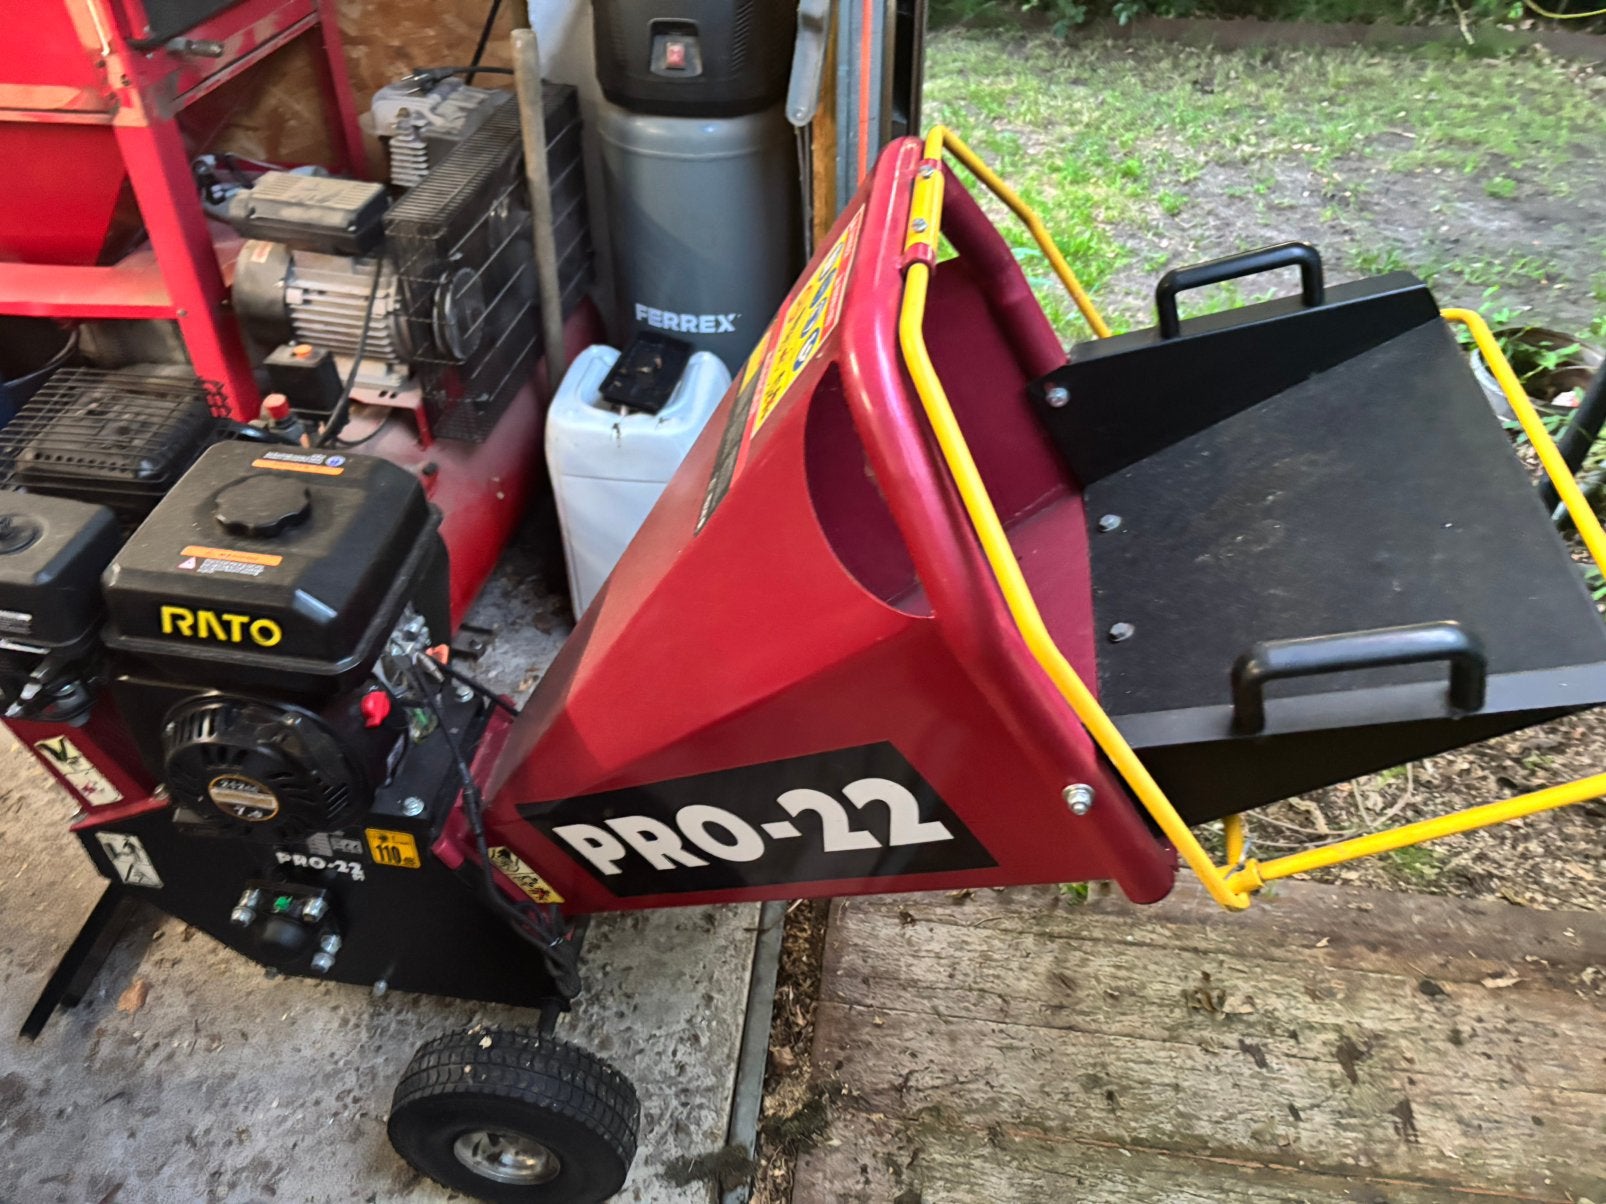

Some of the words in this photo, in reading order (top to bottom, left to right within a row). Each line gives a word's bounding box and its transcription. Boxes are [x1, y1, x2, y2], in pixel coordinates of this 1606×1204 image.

[635, 303, 737, 333] FERREX
[161, 605, 282, 647] RATO
[552, 777, 955, 875] PRO-22
